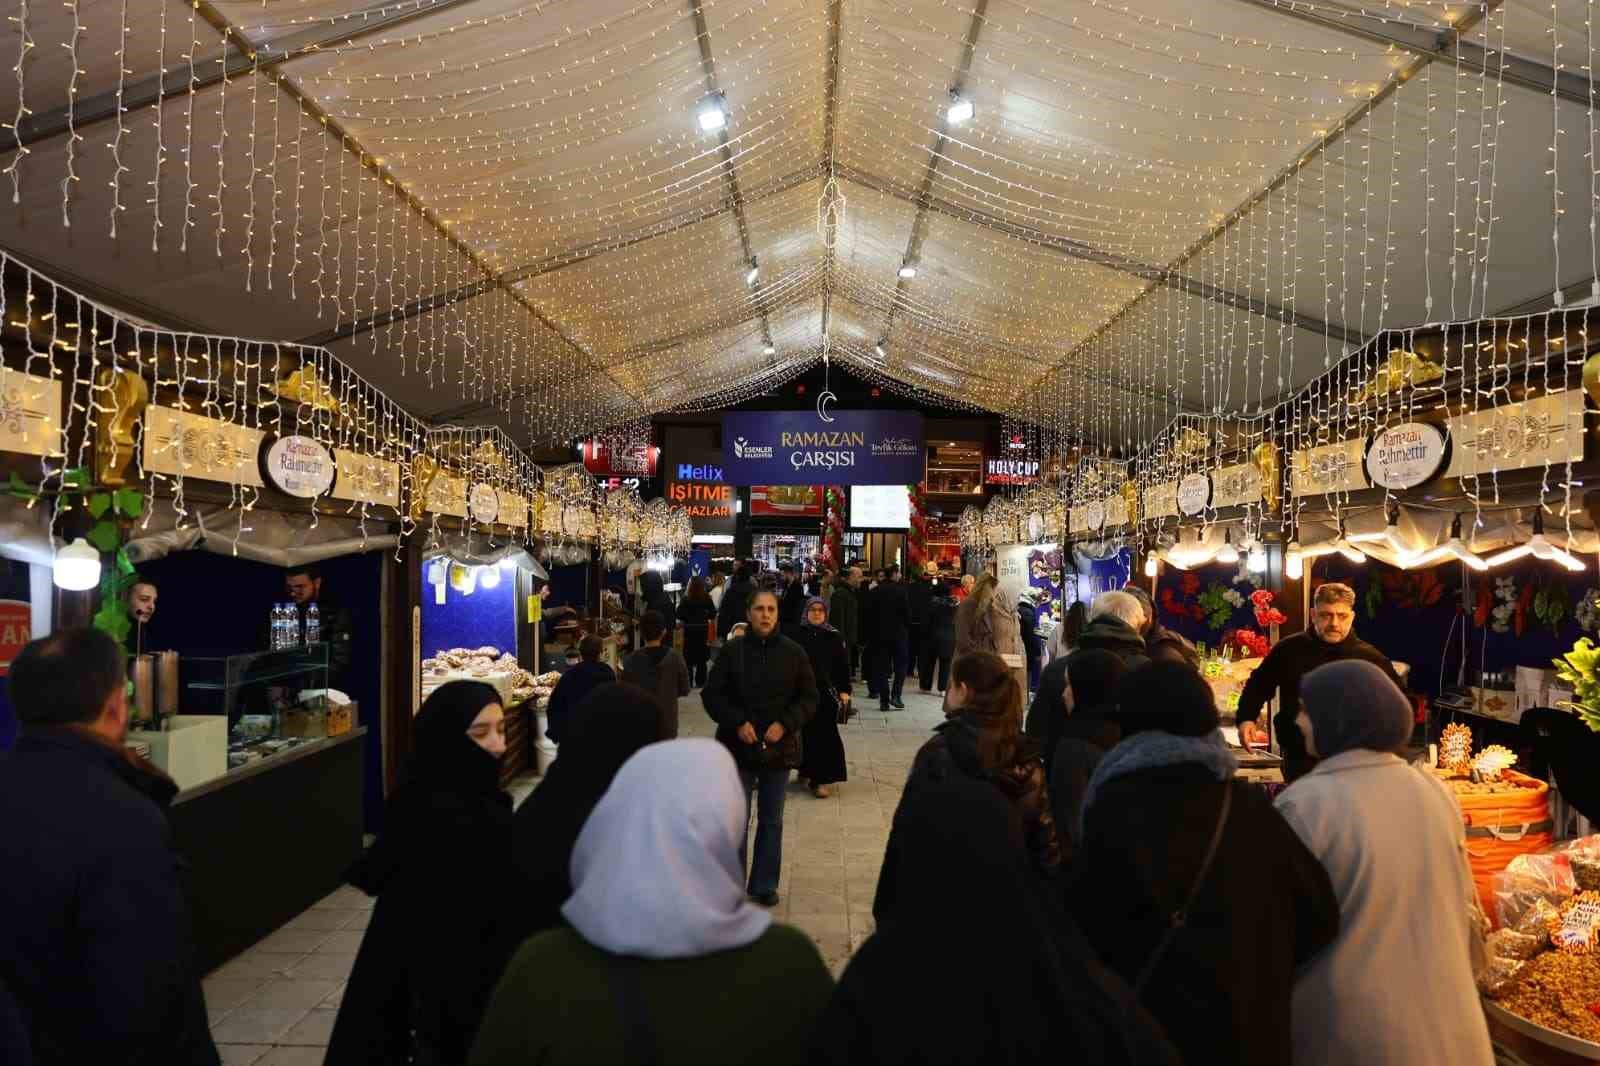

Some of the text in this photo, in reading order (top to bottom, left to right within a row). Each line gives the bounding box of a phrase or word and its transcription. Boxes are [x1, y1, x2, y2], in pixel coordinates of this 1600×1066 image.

[781, 431, 865, 447] RAMAZAN
[790, 451, 855, 470] ÇARŞISI
[989, 460, 1039, 476] HOLY CUP
[678, 463, 723, 480] Helix
[670, 483, 732, 502] İŞİTME
